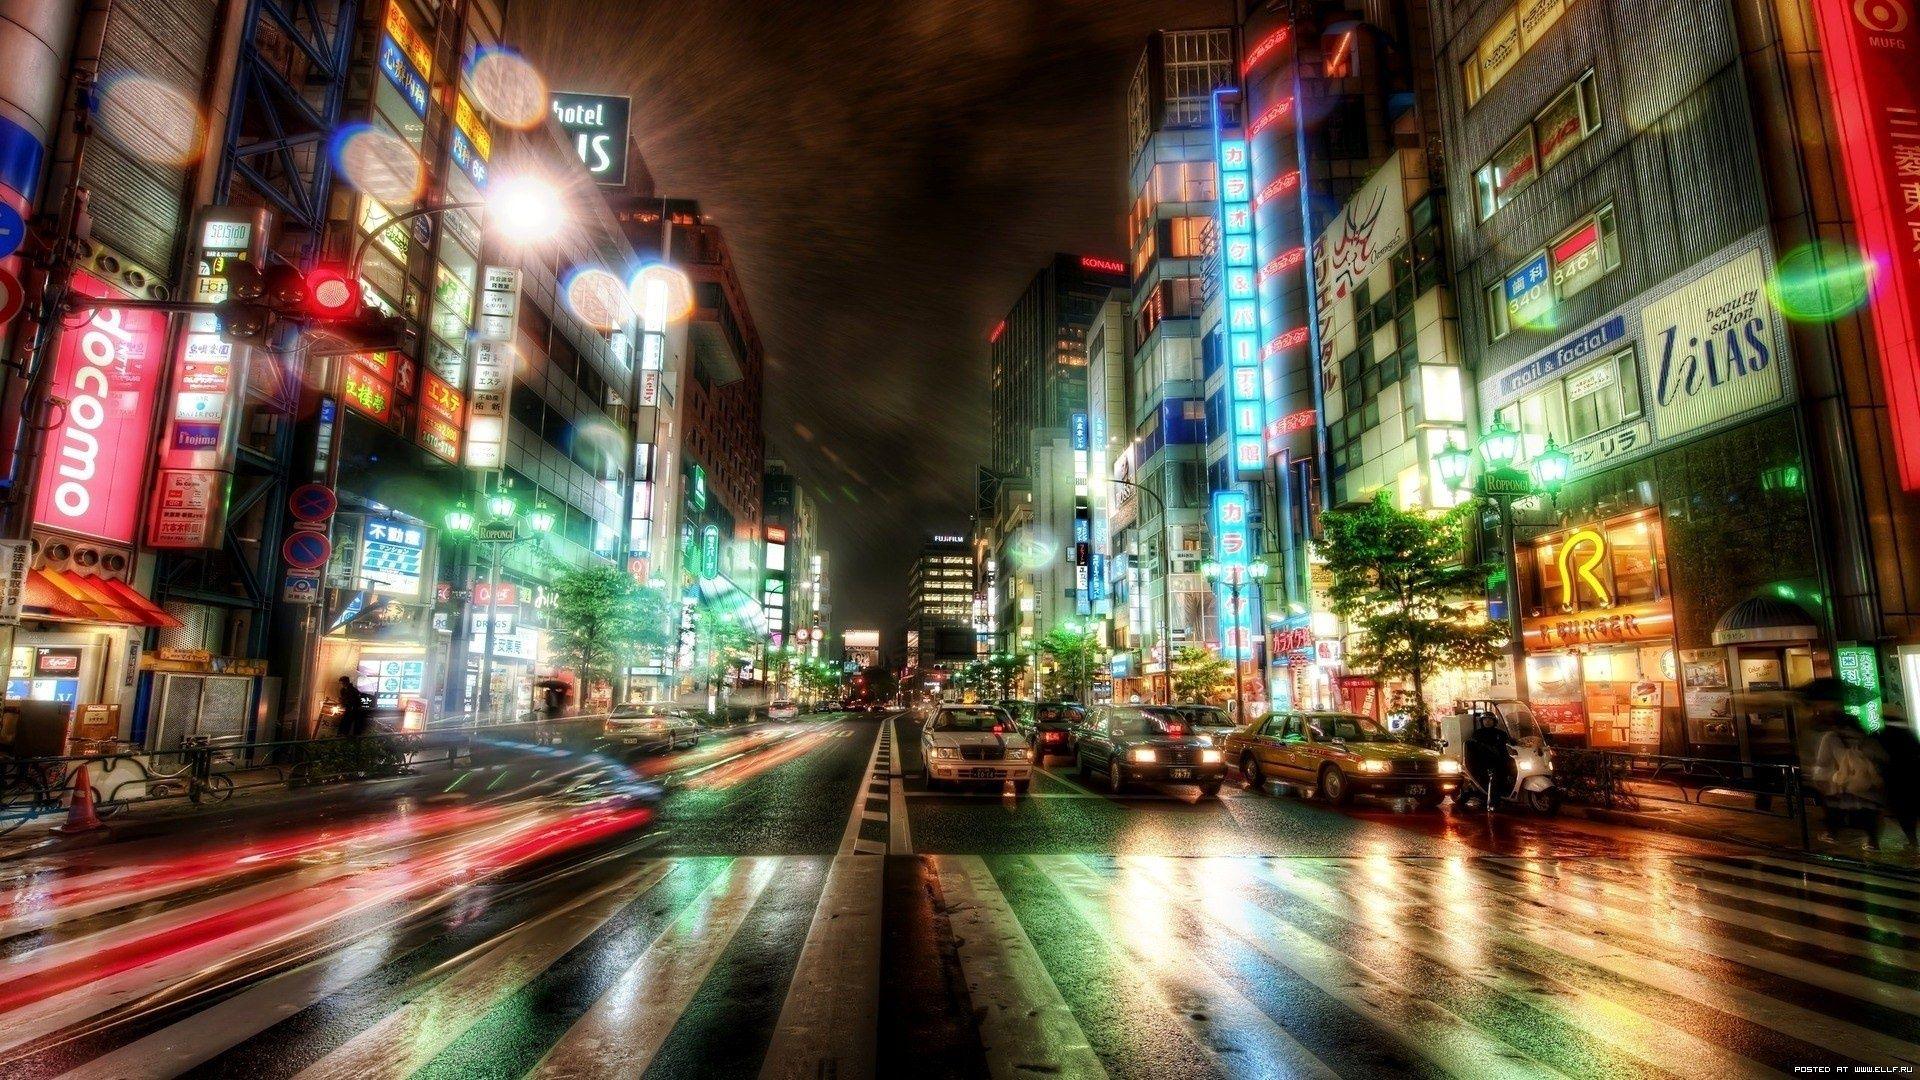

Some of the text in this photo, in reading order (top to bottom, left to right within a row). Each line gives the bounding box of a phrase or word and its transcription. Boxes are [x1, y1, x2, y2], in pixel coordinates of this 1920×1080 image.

[1869, 37, 1905, 49] MUFG
[553, 101, 603, 126] hotel
[1082, 256, 1124, 272] KONAMI
[1511, 262, 1544, 296] 歯科
[1706, 289, 1759, 323] beauty
[1710, 307, 1754, 335] salon
[1511, 362, 1542, 391] nail
[1556, 326, 1608, 367] facial
[428, 380, 461, 412] エステ
[54, 304, 131, 517] docomo
[1600, 430, 1638, 458] リラ
[1488, 474, 1529, 491] ROPPONGI
[480, 527, 513, 539] ROPPONGI
[934, 535, 964, 543] FUJIFILM
[1221, 503, 1248, 650] カラオケ館
[1840, 651, 1861, 686] 歯科
